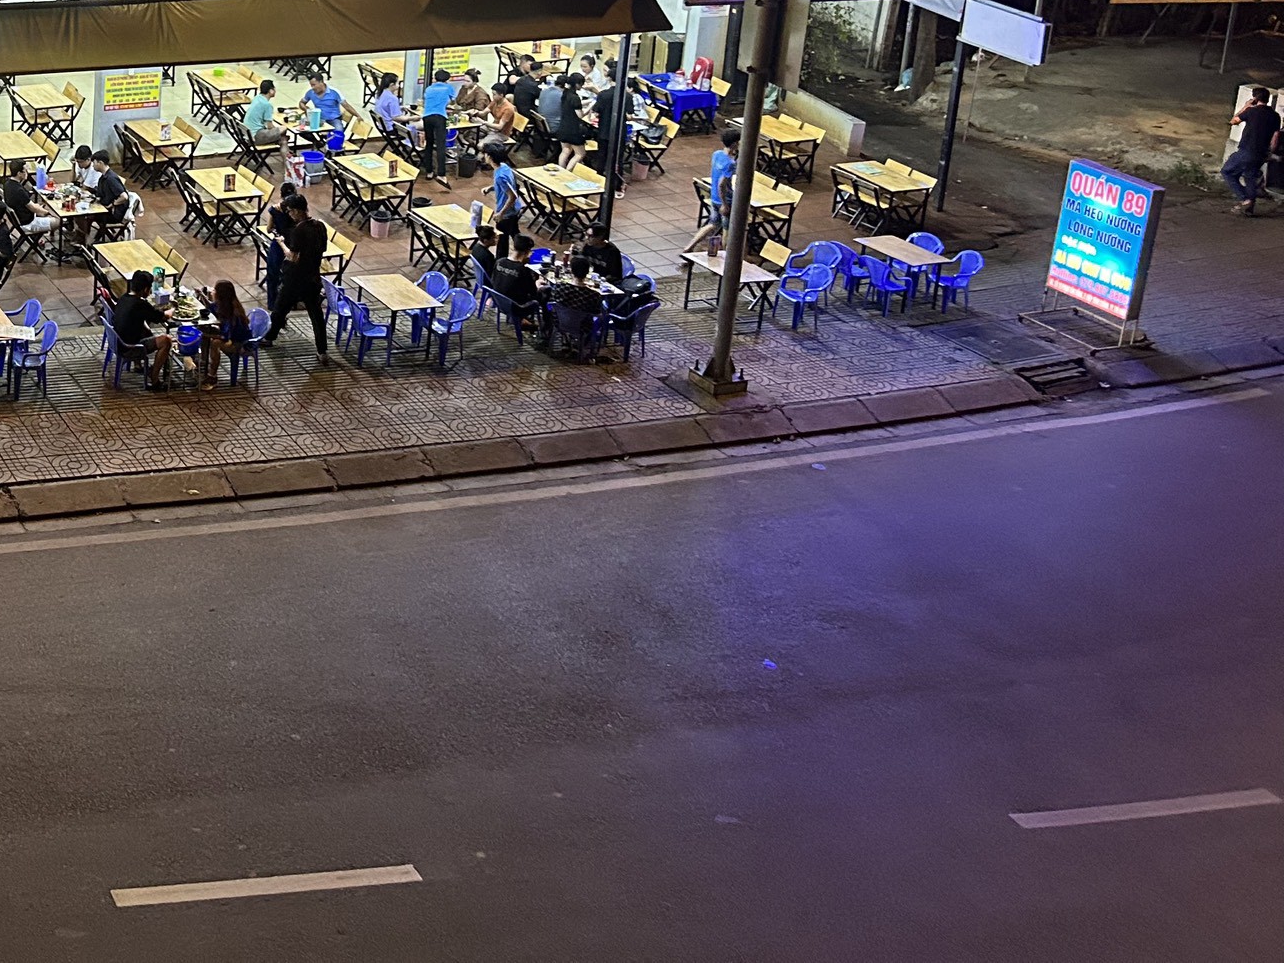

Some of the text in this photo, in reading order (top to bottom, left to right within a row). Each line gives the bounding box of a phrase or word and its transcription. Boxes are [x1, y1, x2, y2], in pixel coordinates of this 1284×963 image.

[1070, 170, 1147, 217] QUÁN 89
[1084, 205, 1104, 222] HEO
